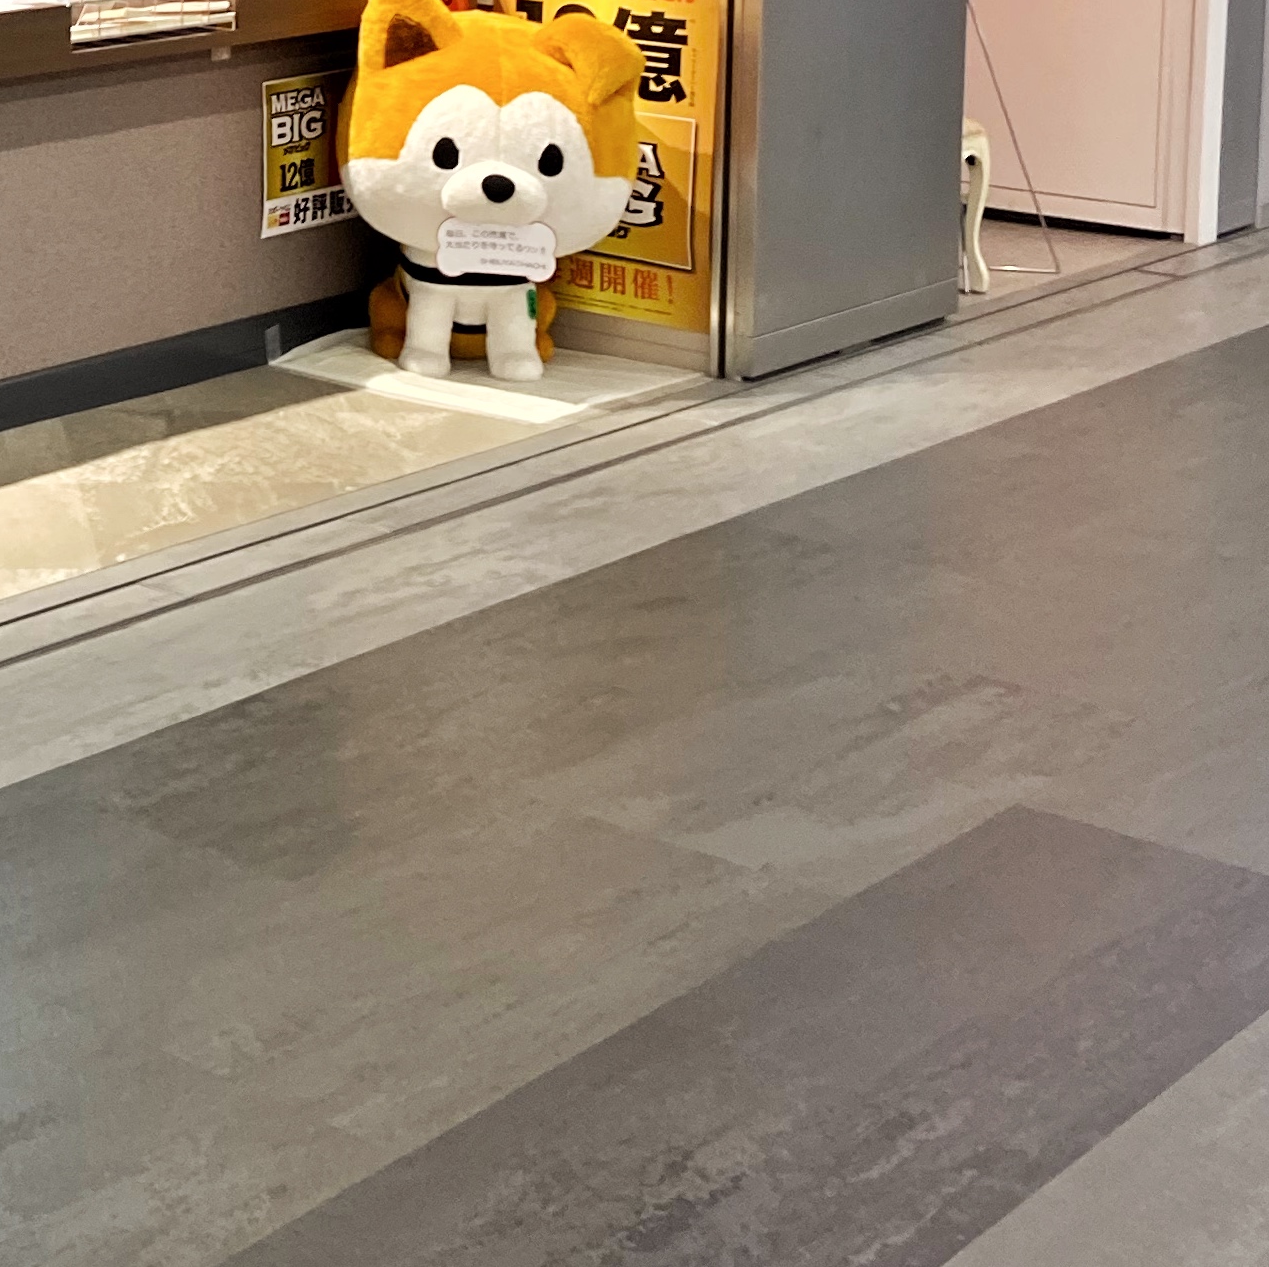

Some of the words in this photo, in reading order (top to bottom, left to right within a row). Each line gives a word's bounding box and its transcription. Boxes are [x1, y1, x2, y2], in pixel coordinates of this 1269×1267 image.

[270, 86, 325, 115] MEGA
[270, 109, 325, 148] BIG
[279, 158, 315, 193] 12億
[553, 256, 676, 305] 週開催!
